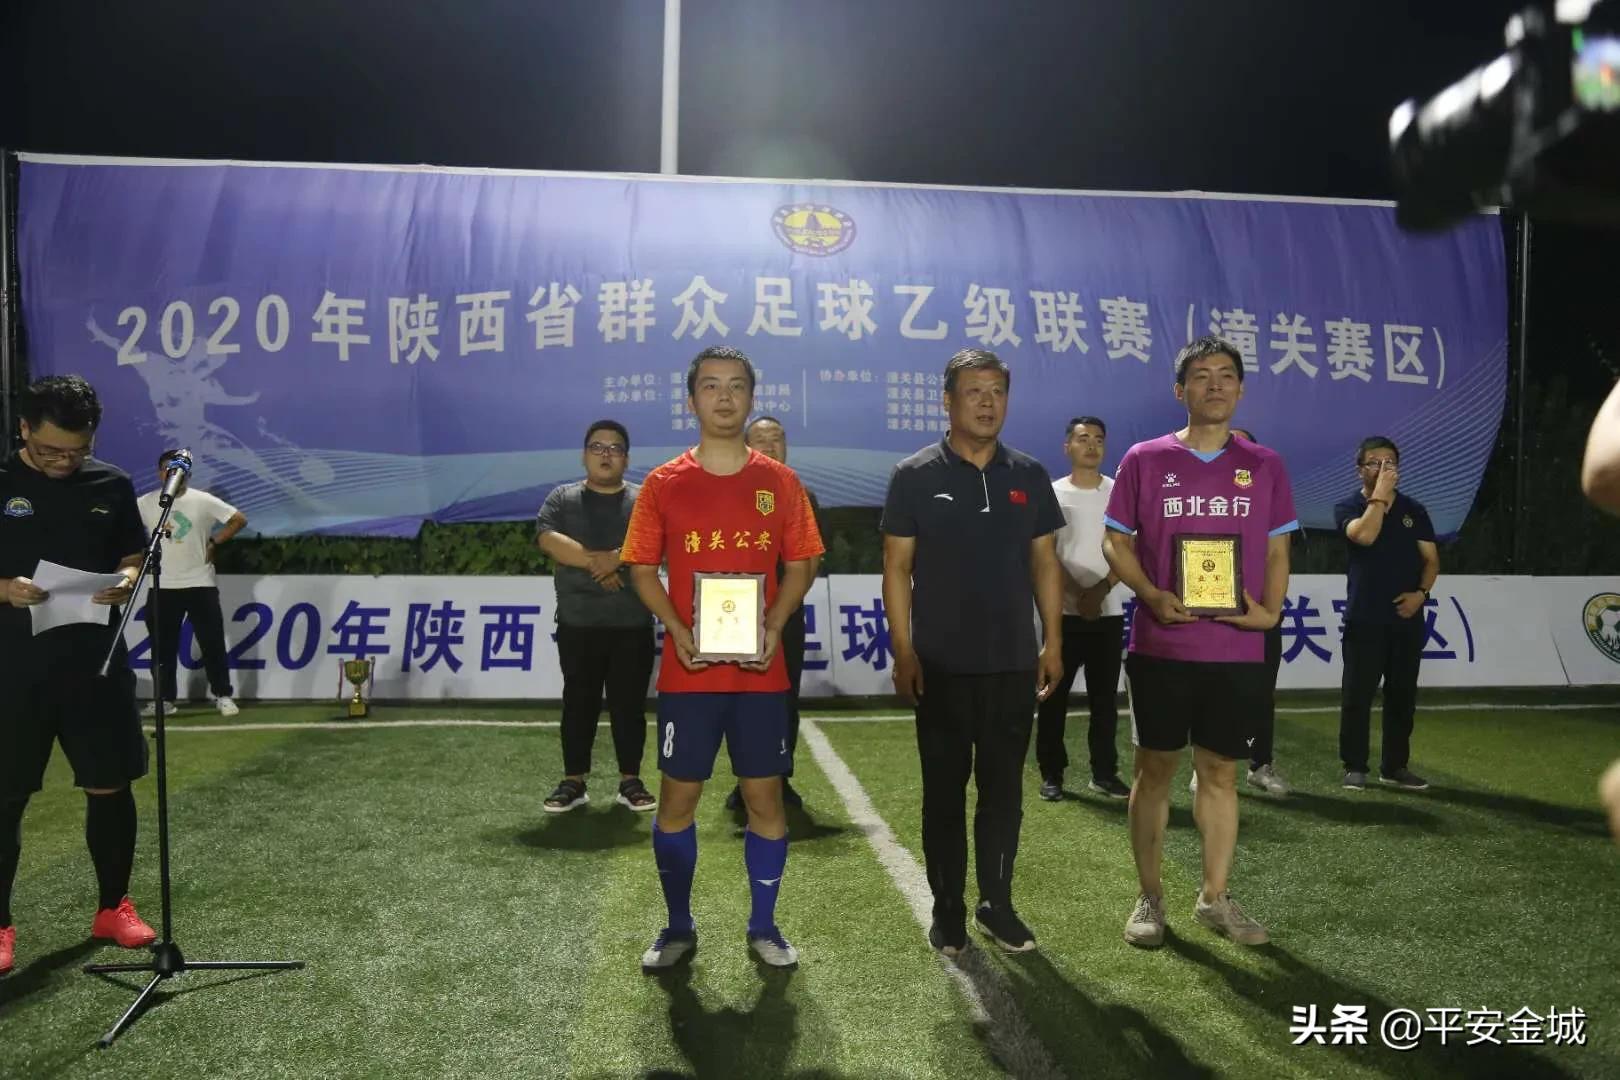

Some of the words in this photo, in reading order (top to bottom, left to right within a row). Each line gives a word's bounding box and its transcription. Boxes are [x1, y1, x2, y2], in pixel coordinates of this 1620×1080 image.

[1163, 495, 1251, 517] 西北金行
[684, 529, 772, 553] 潼关公安
[663, 721, 675, 758] 8
